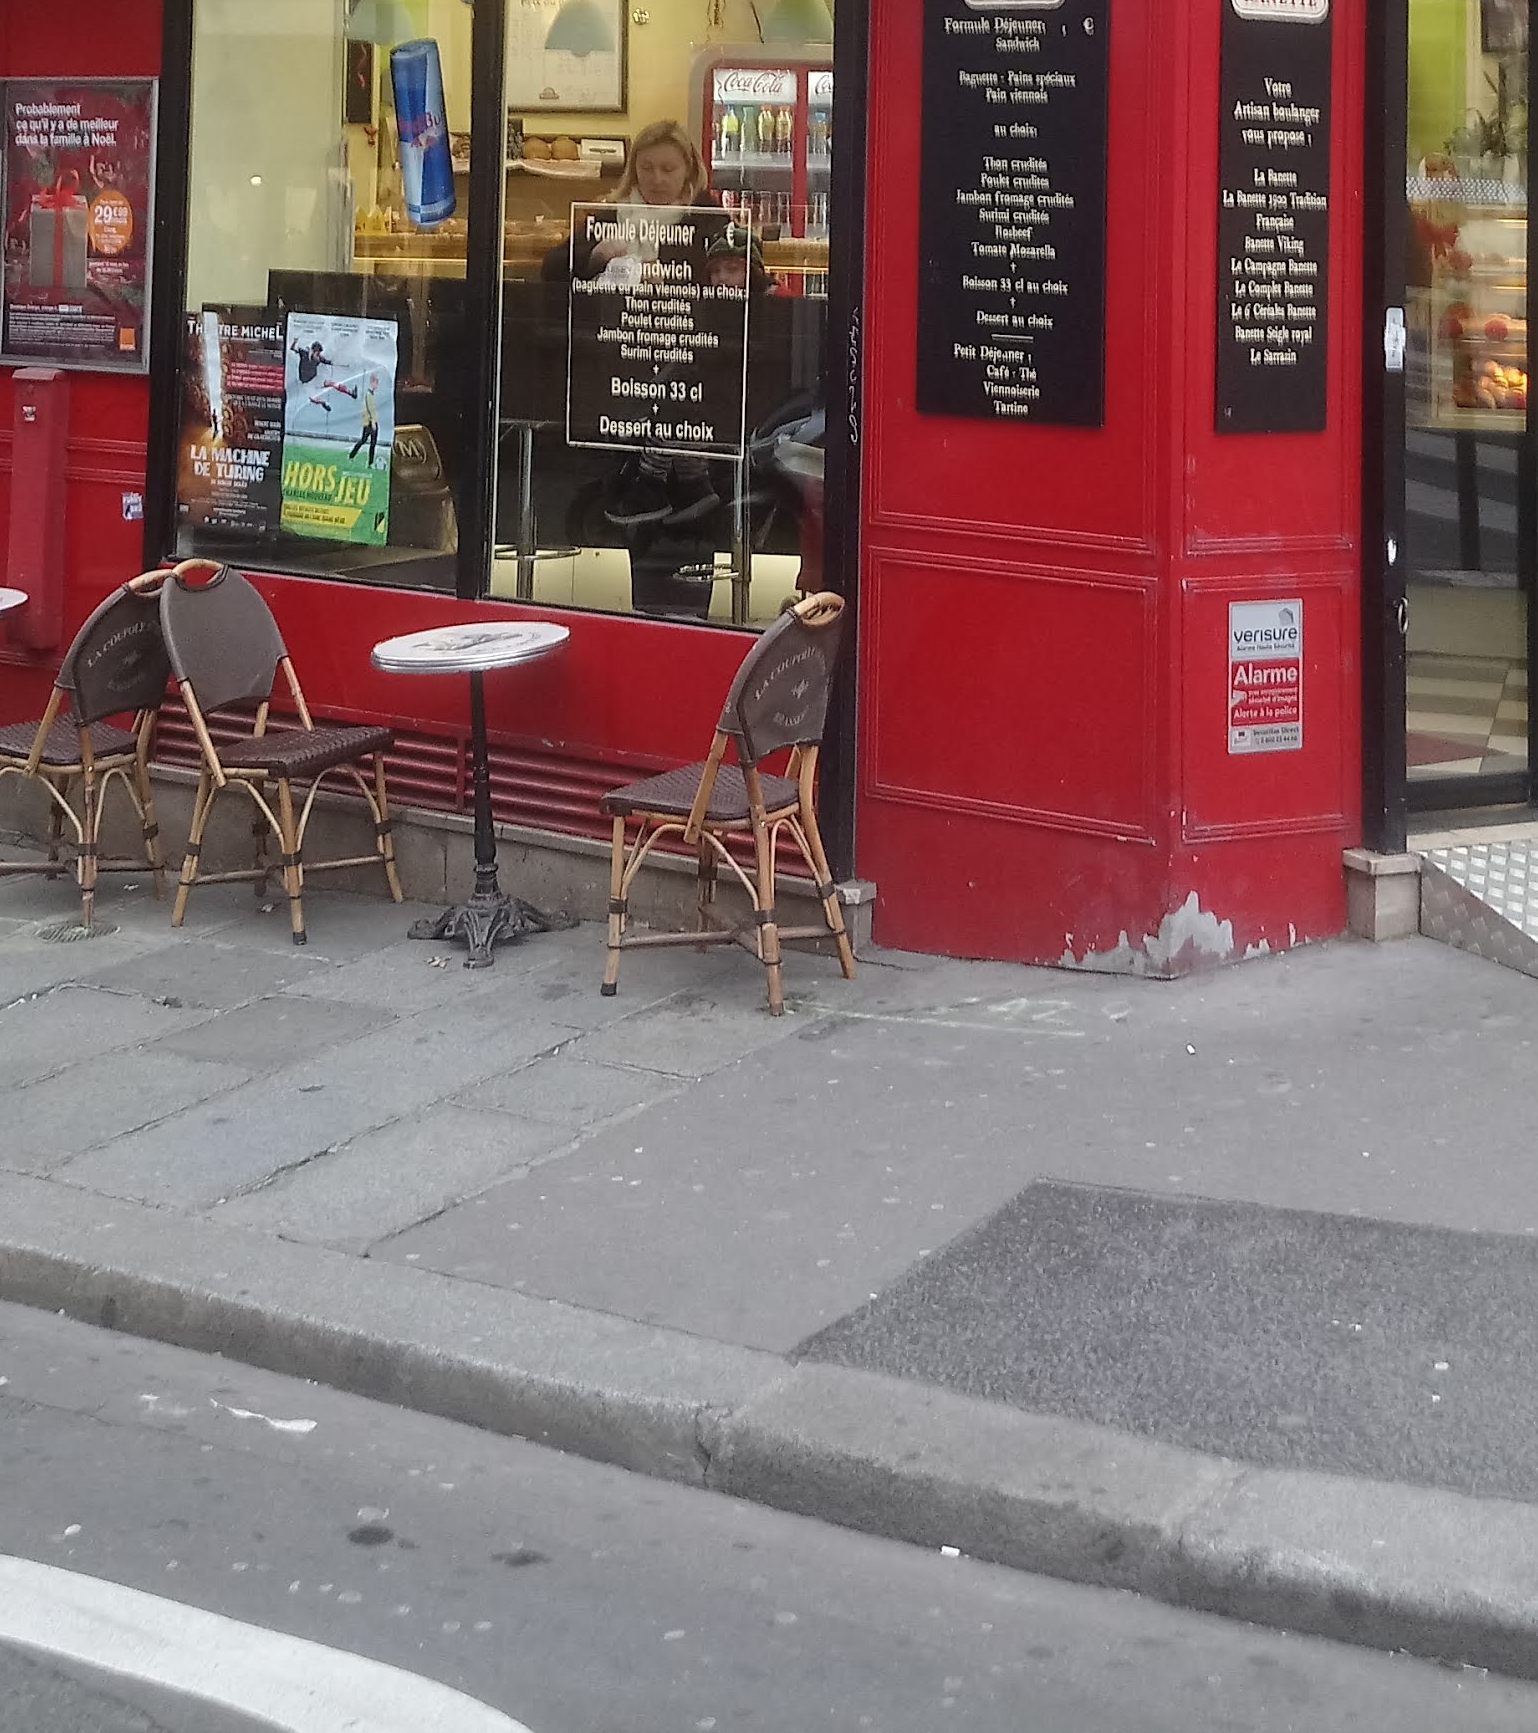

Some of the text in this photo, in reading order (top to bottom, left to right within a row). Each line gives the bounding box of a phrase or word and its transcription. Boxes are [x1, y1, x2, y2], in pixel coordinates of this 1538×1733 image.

[944, 17, 990, 32] Formule
[995, 37, 1040, 50] Sandwich
[724, 72, 784, 94] Coca-Cola
[959, 70, 998, 86] Baguette
[1264, 77, 1292, 96] Votre
[15, 102, 81, 116] Probablement
[1234, 101, 1320, 126] Artisan boulanger
[80, 117, 119, 131] meilleur
[15, 132, 38, 146] dans
[50, 133, 81, 146] famille
[983, 156, 1008, 169] Thon
[981, 173, 1009, 187] Poulet
[1254, 169, 1265, 185] La
[956, 189, 1074, 209] Jambon fromage crudités
[1223, 190, 1234, 205] La
[1290, 192, 1327, 209] Tradition
[979, 208, 1049, 223] Surimi crudités
[586, 216, 636, 243] Formule
[639, 219, 695, 249] Déjeuner
[1277, 235, 1304, 256] Viking
[1245, 258, 1286, 277] Campagne
[633, 282, 714, 301] pain viennois) au
[963, 275, 997, 289] Boisson
[1000, 278, 1011, 290] 33
[625, 296, 691, 313] Thon crudités
[621, 312, 694, 329] Poulet crudités
[977, 310, 1009, 324] Dessert
[187, 318, 238, 337] THTRE
[597, 327, 719, 347] Jambon fromage crudités
[621, 344, 693, 363] Surimi crudités
[987, 365, 1009, 378] Café
[611, 376, 702, 403] Boisson 33 cl
[983, 381, 1040, 397] Viennoiserie
[994, 400, 1028, 413] Tartine
[599, 416, 714, 441] Dessert au choix
[190, 444, 270, 467] LA MACHINE
[194, 461, 264, 482] DE TURING
[284, 460, 337, 493] HORS
[335, 476, 372, 506] JEU
[1234, 627, 1297, 643] verisure
[1234, 663, 1298, 685] Alarme
[1234, 709, 1257, 719] Alerte
[1275, 706, 1297, 718] police
